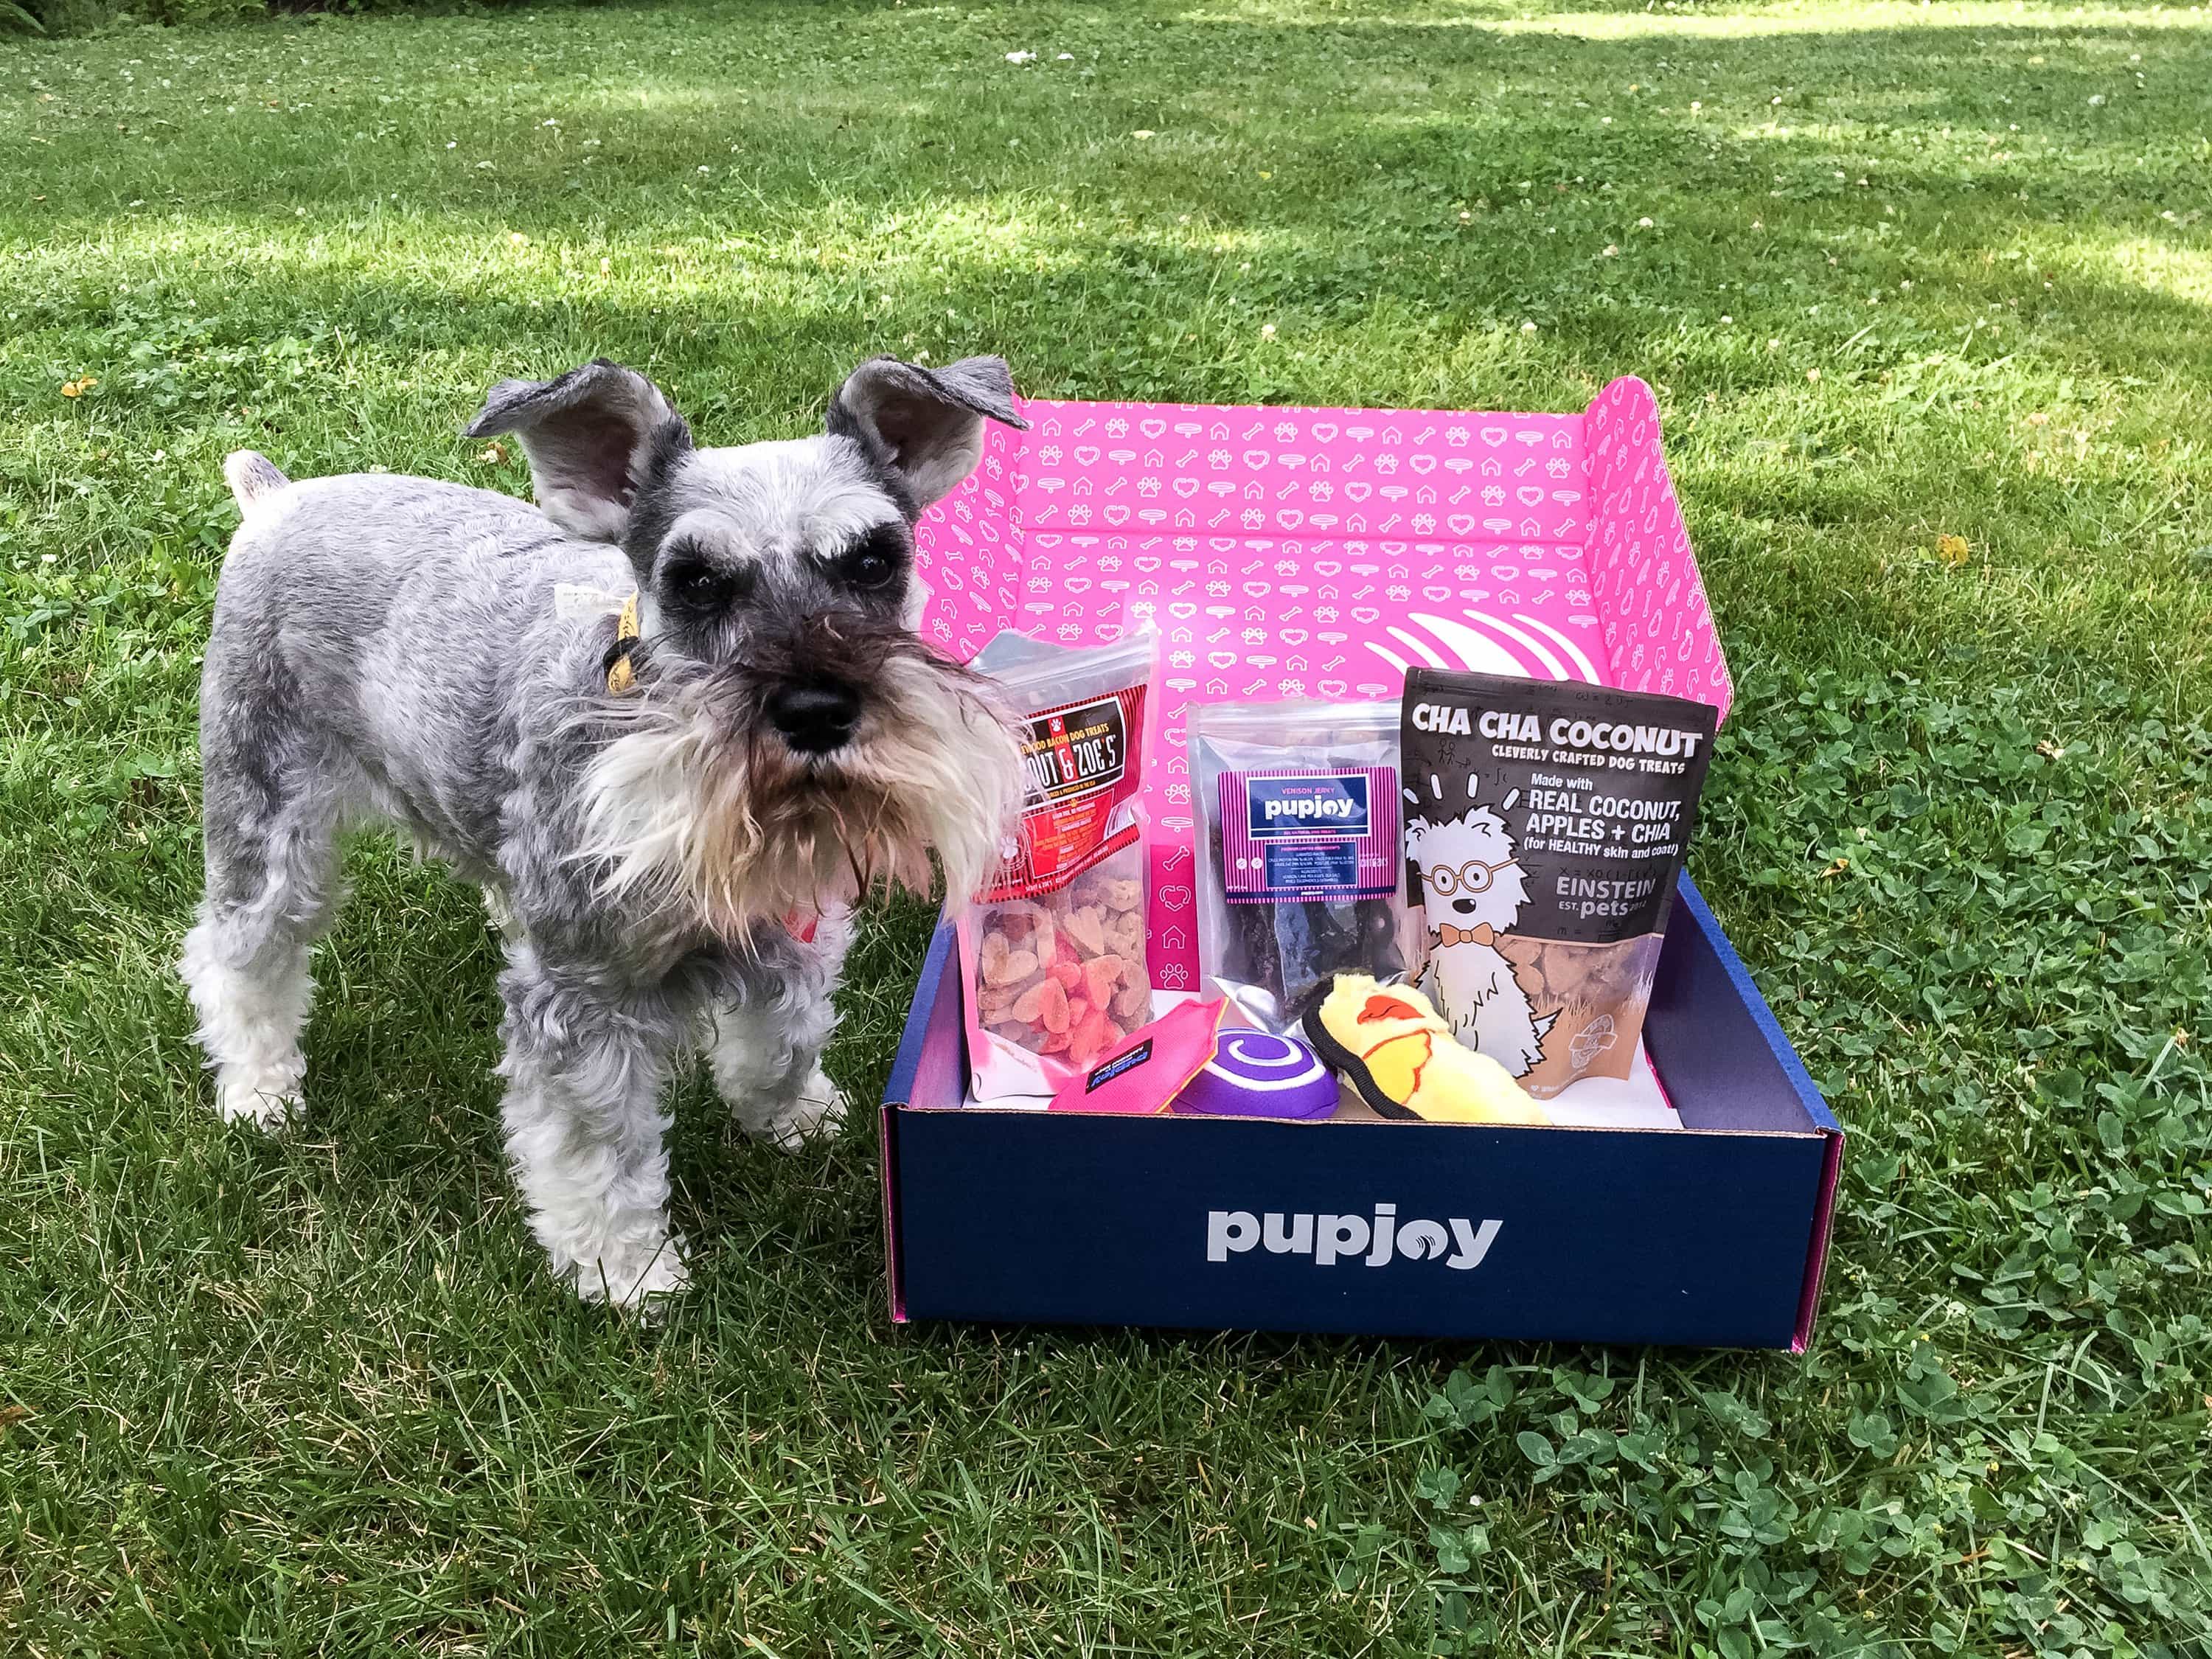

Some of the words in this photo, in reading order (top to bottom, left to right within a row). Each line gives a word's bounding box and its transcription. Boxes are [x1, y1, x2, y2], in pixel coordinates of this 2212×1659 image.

[1047, 734, 1070, 747] BACON
[1069, 729, 1085, 742] DOG
[1085, 723, 1110, 737] TREATS
[1411, 703, 1472, 736] CHA
[1478, 710, 1542, 742] CHA
[1549, 718, 1703, 758] COCONUT
[1492, 744, 1549, 762] CLEVERLY
[1552, 750, 1605, 767] CRAFTED
[1608, 756, 1635, 771] DOG
[1638, 759, 1686, 774] TREATS
[1281, 787, 1312, 795] VENISON
[1531, 773, 1563, 787] Made
[1566, 776, 1593, 791] with
[1265, 795, 1354, 820] pupjoy
[1528, 789, 1582, 813] REAL
[1589, 795, 1681, 821] COCONUT,
[1526, 813, 1605, 840] APPLES
[1611, 824, 1626, 841] +
[1632, 822, 1671, 844] CHIA
[1523, 837, 1546, 851] (for
[1549, 839, 1601, 856] HEALTHY
[1603, 846, 1629, 858] skin
[1631, 847, 1650, 859] and
[1557, 876, 1657, 899] EINSTEIN
[1559, 901, 1579, 911] EST.
[1580, 900, 1629, 919] pets
[1206, 1203, 1504, 1270] pupjoy
